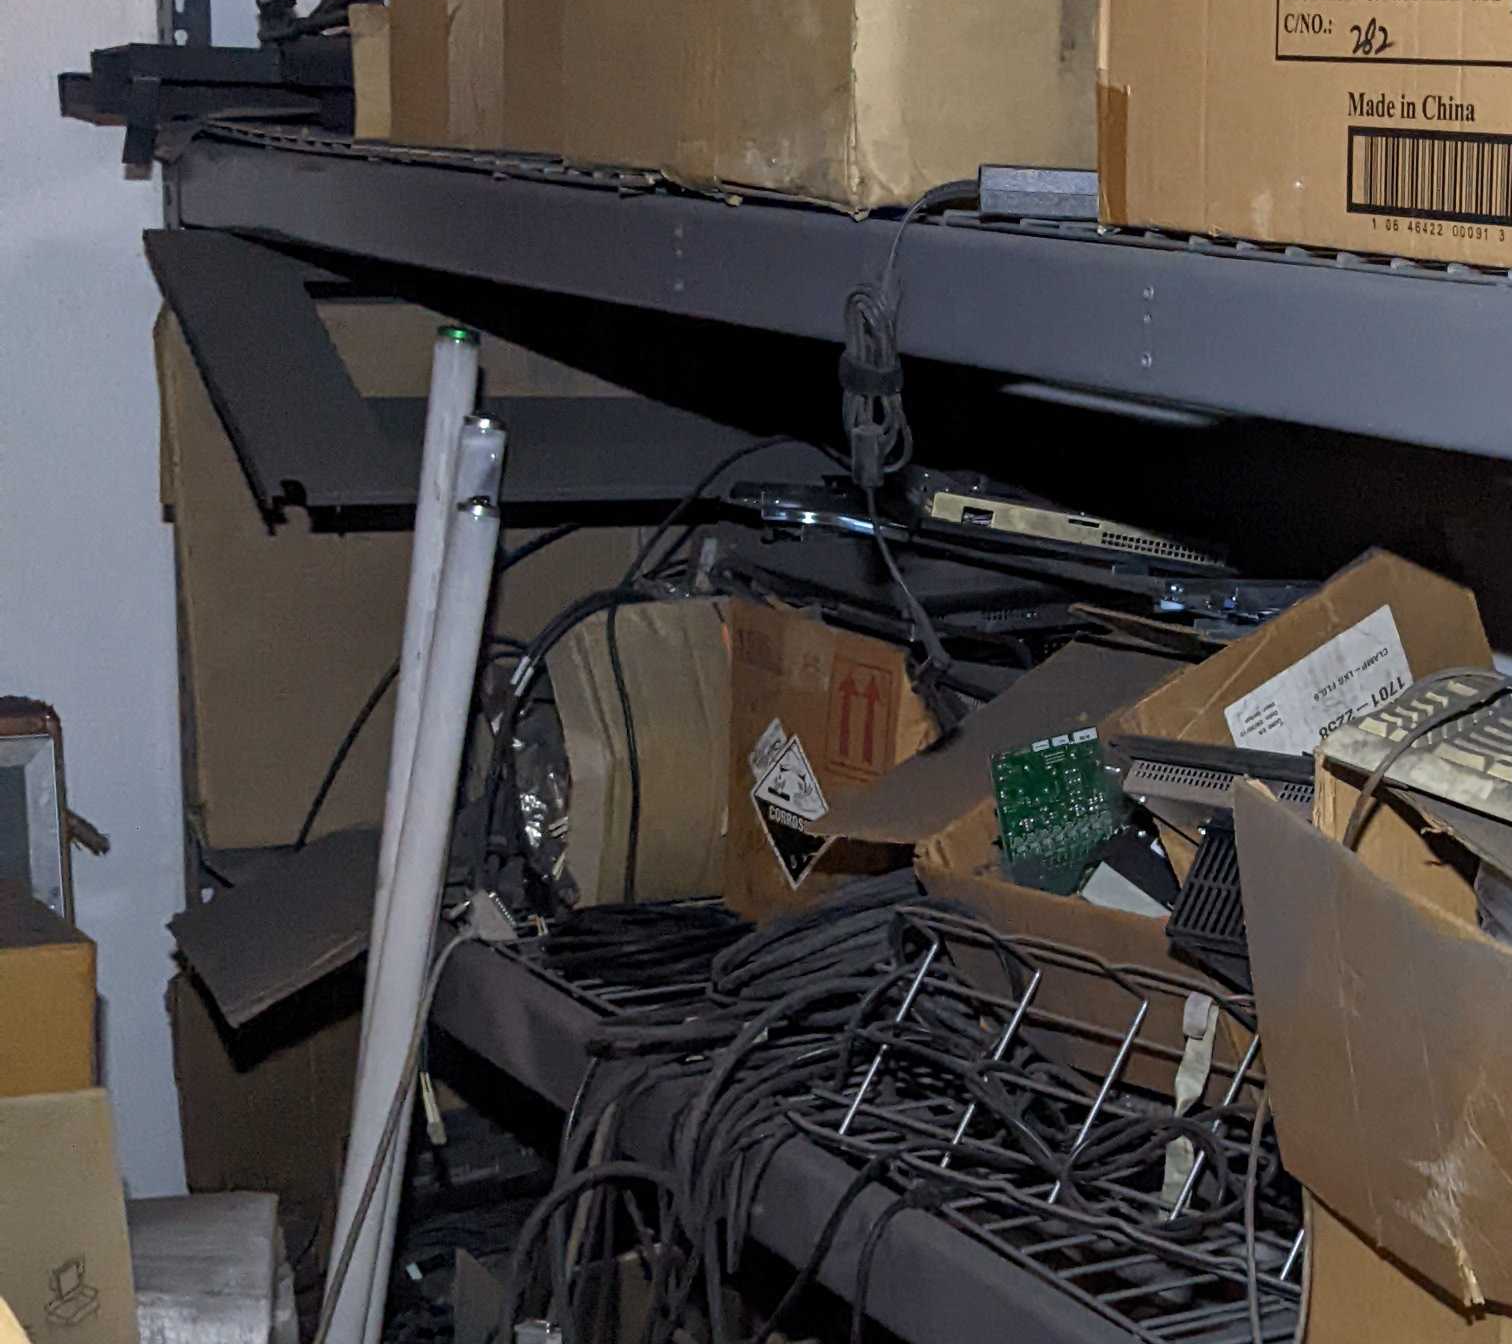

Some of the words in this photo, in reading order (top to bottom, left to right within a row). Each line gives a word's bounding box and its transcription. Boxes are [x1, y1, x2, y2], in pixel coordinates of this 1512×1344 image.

[1347, 91, 1396, 119] Made
[1401, 93, 1416, 120] in
[1421, 94, 1476, 123] China
